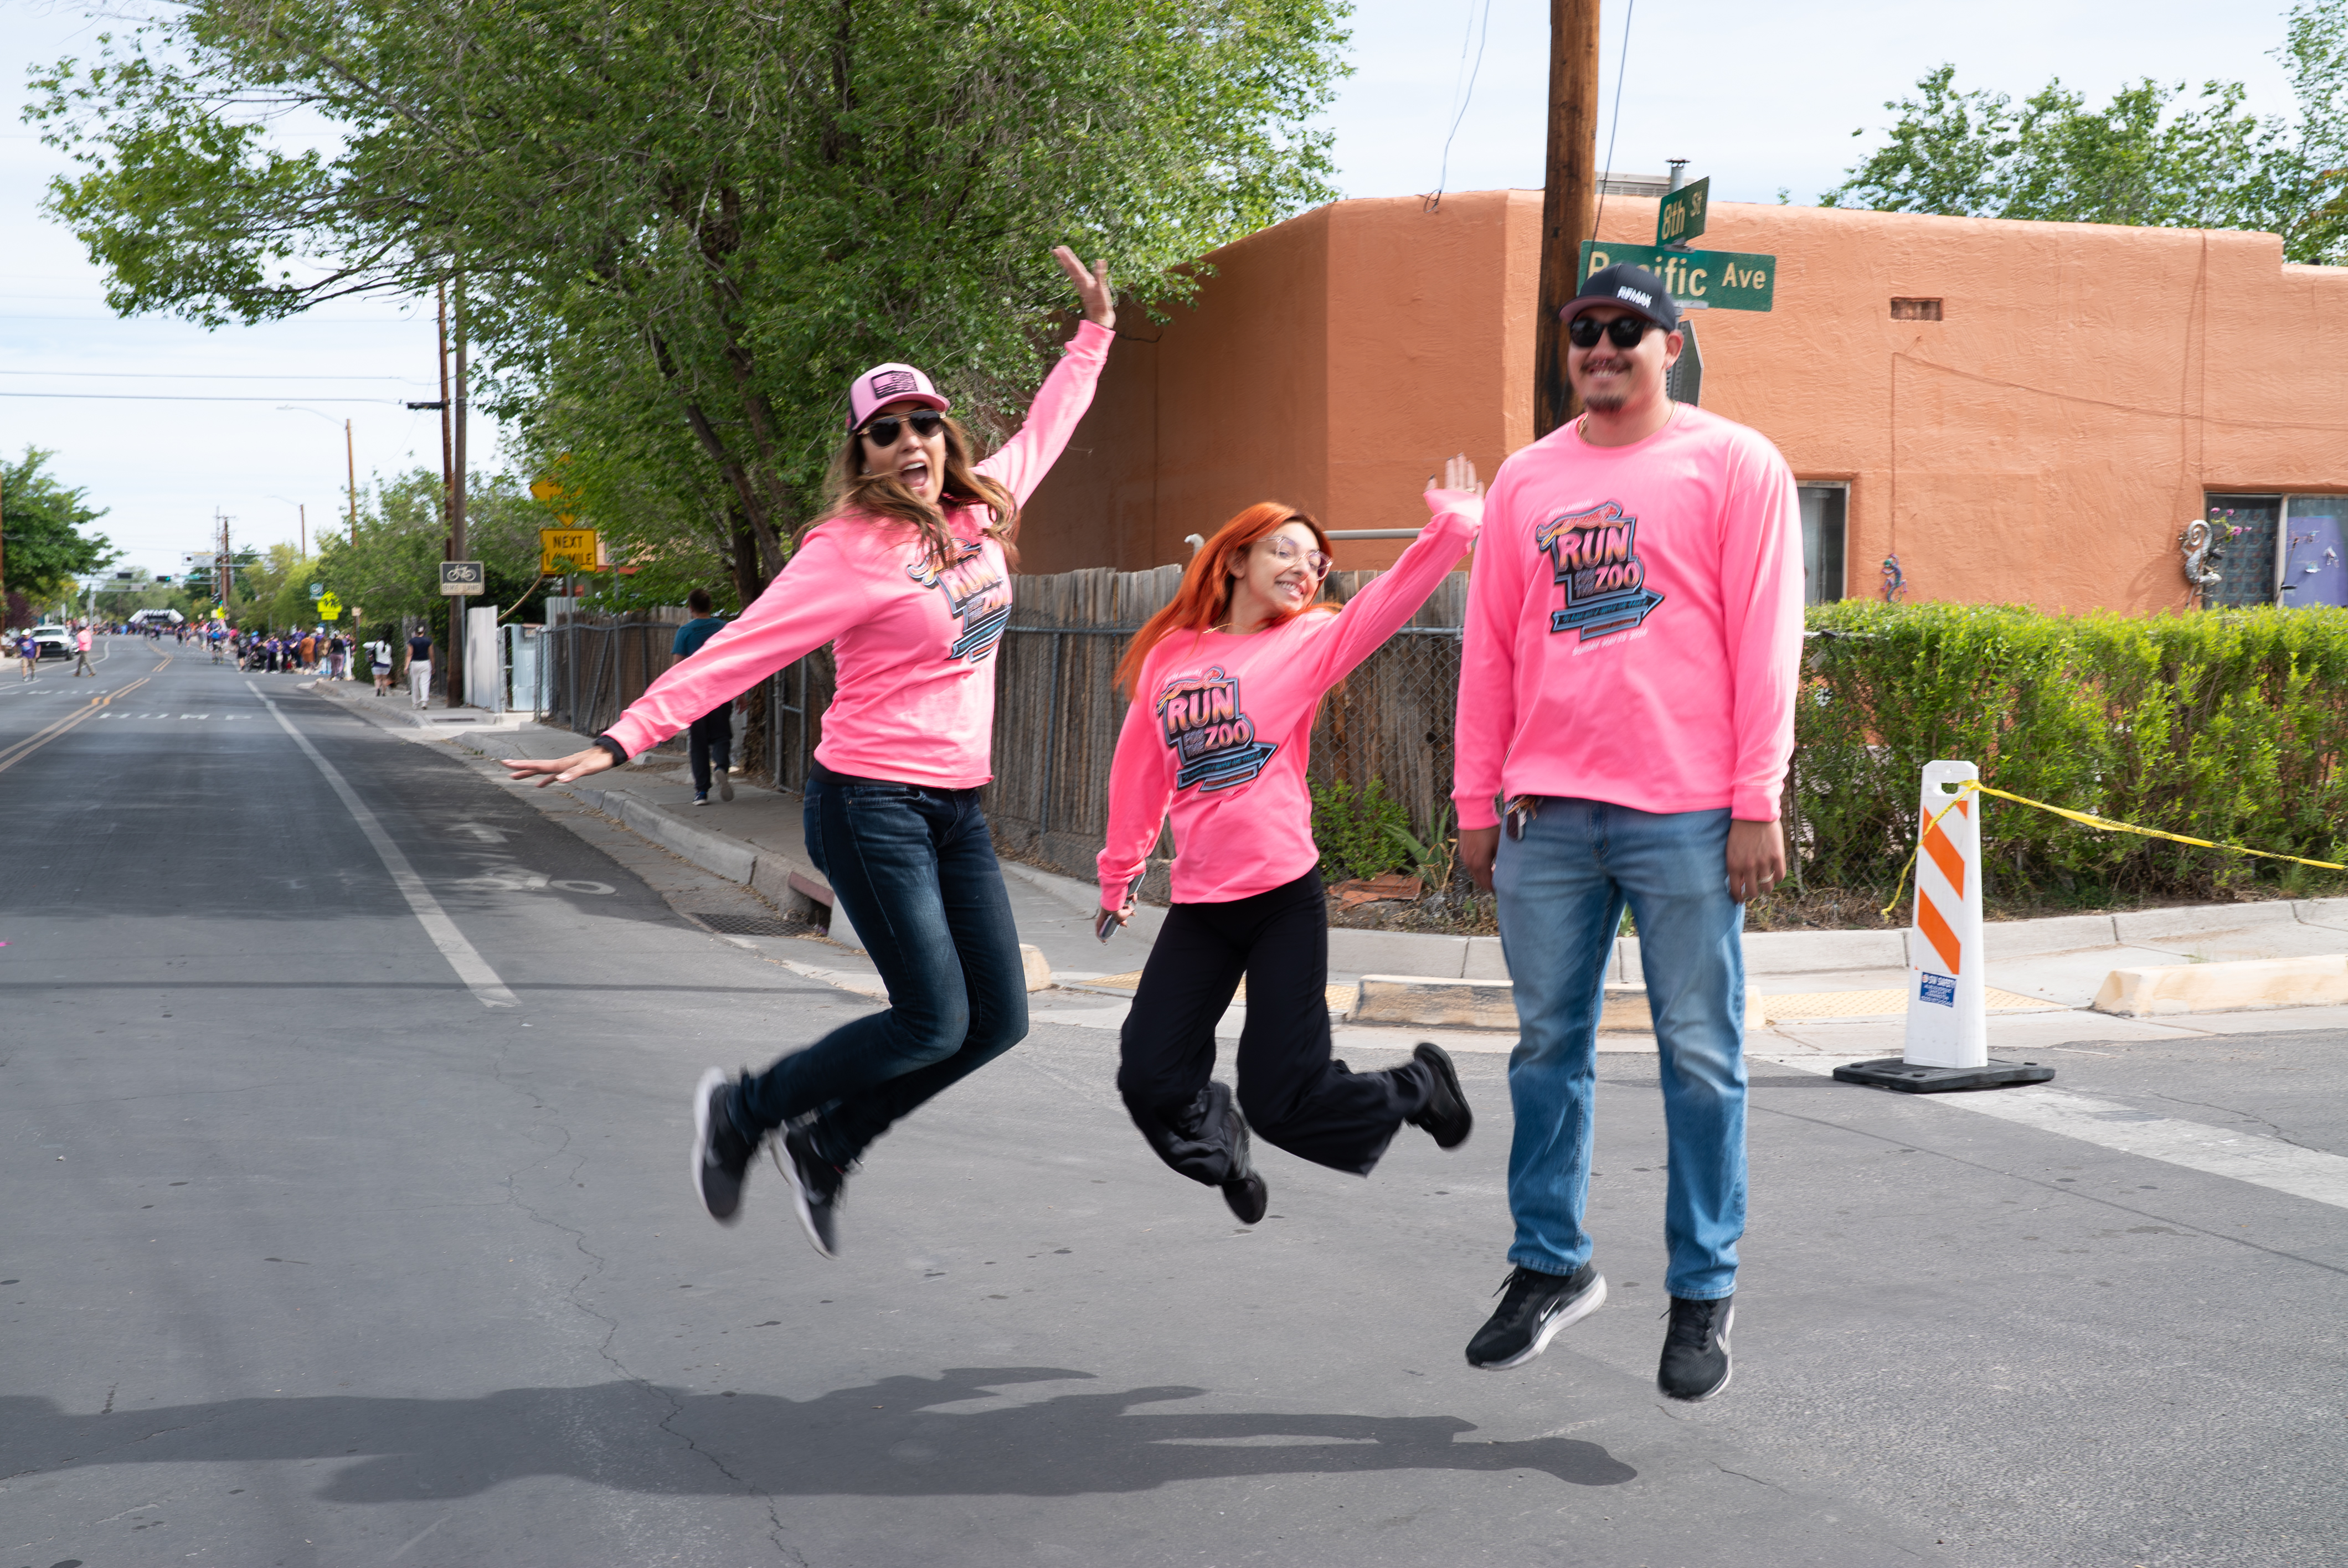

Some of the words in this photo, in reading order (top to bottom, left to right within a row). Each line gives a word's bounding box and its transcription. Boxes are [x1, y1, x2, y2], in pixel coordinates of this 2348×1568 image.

[1661, 198, 1685, 240] 8th
[1690, 190, 1702, 218] St
[1722, 262, 1766, 290] Ave
[553, 535, 584, 548] NEXT
[1557, 522, 1630, 572] RUN
[1594, 561, 1641, 591] ZOO
[1167, 683, 1235, 734] RUN
[1204, 720, 1250, 750] ZOO
